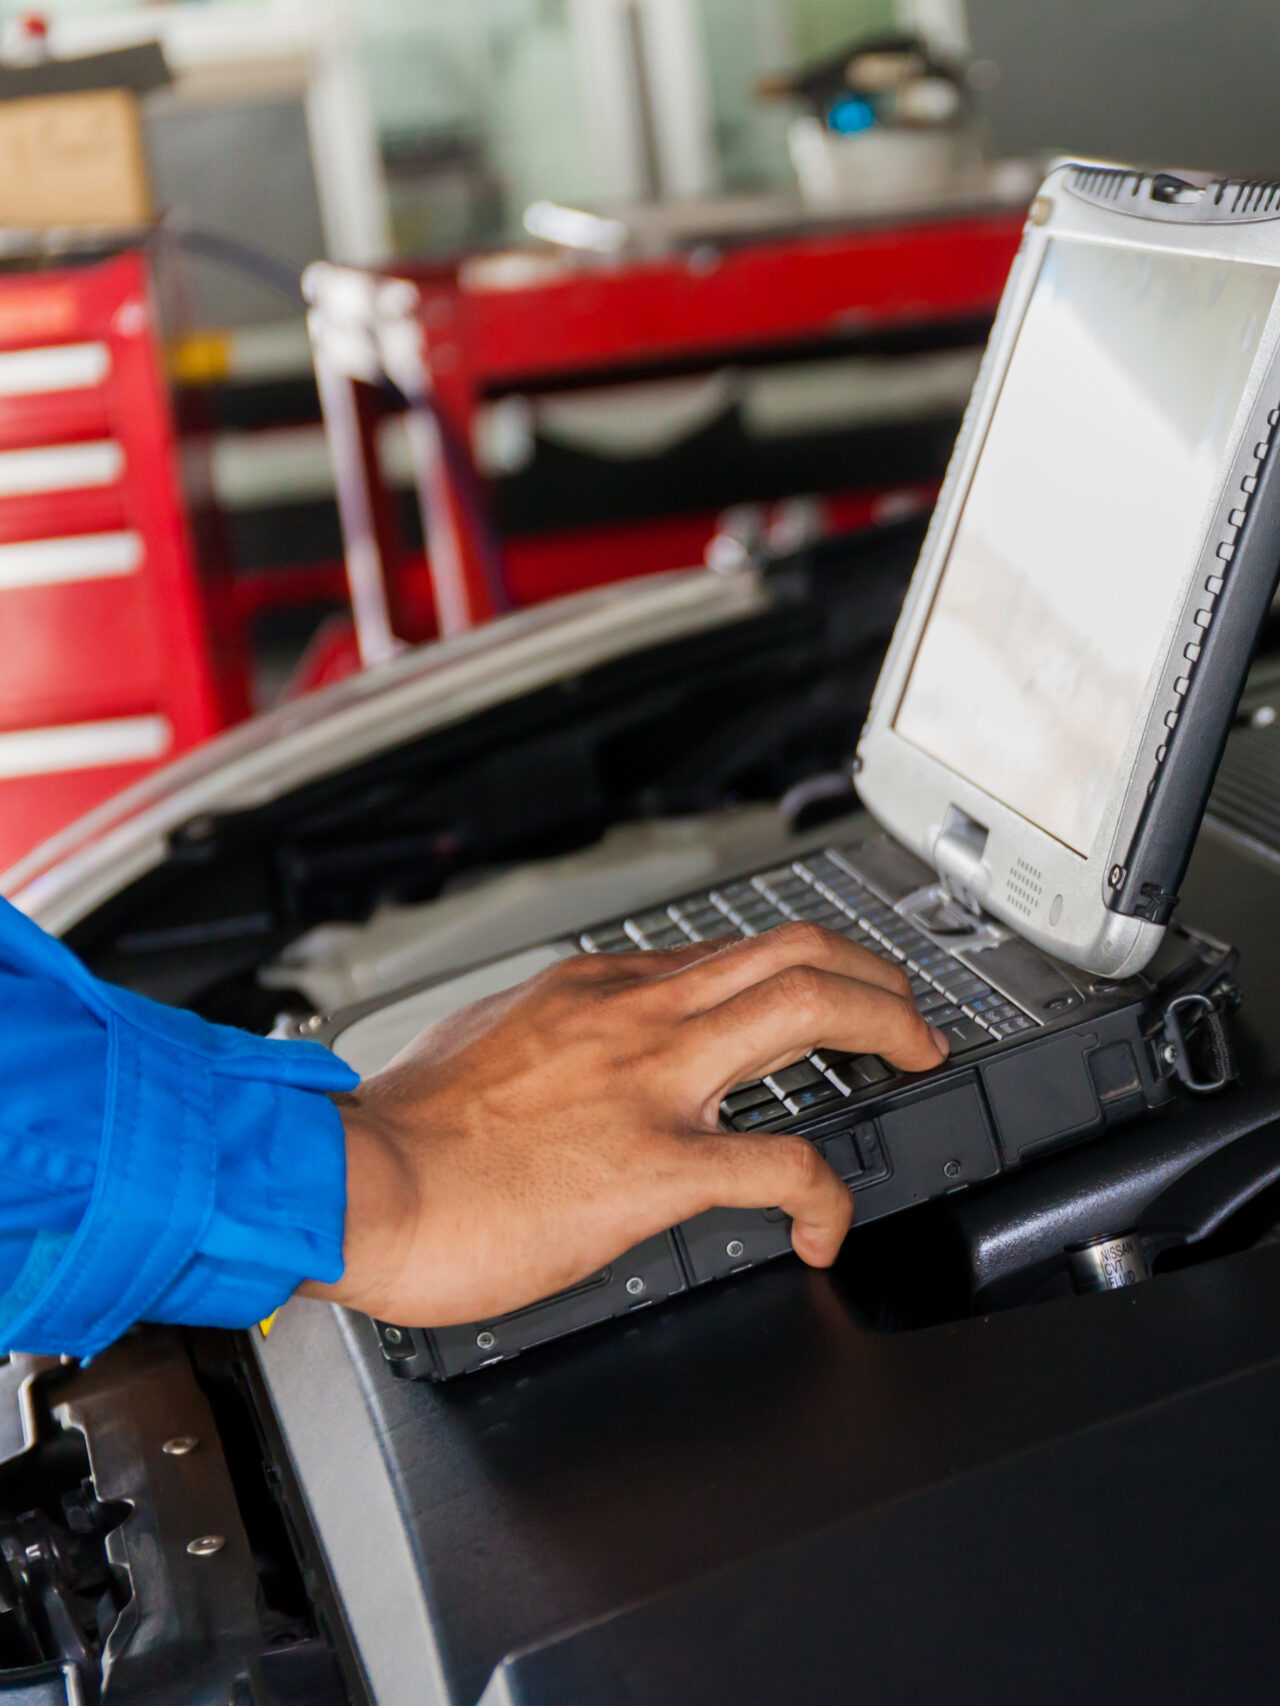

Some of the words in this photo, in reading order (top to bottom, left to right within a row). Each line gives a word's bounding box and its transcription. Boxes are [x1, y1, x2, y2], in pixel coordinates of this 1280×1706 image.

[1100, 1240, 1134, 1262] NISSAN
[1105, 1259, 1123, 1276] CVT
[1108, 1270, 1135, 1288] FLUID
